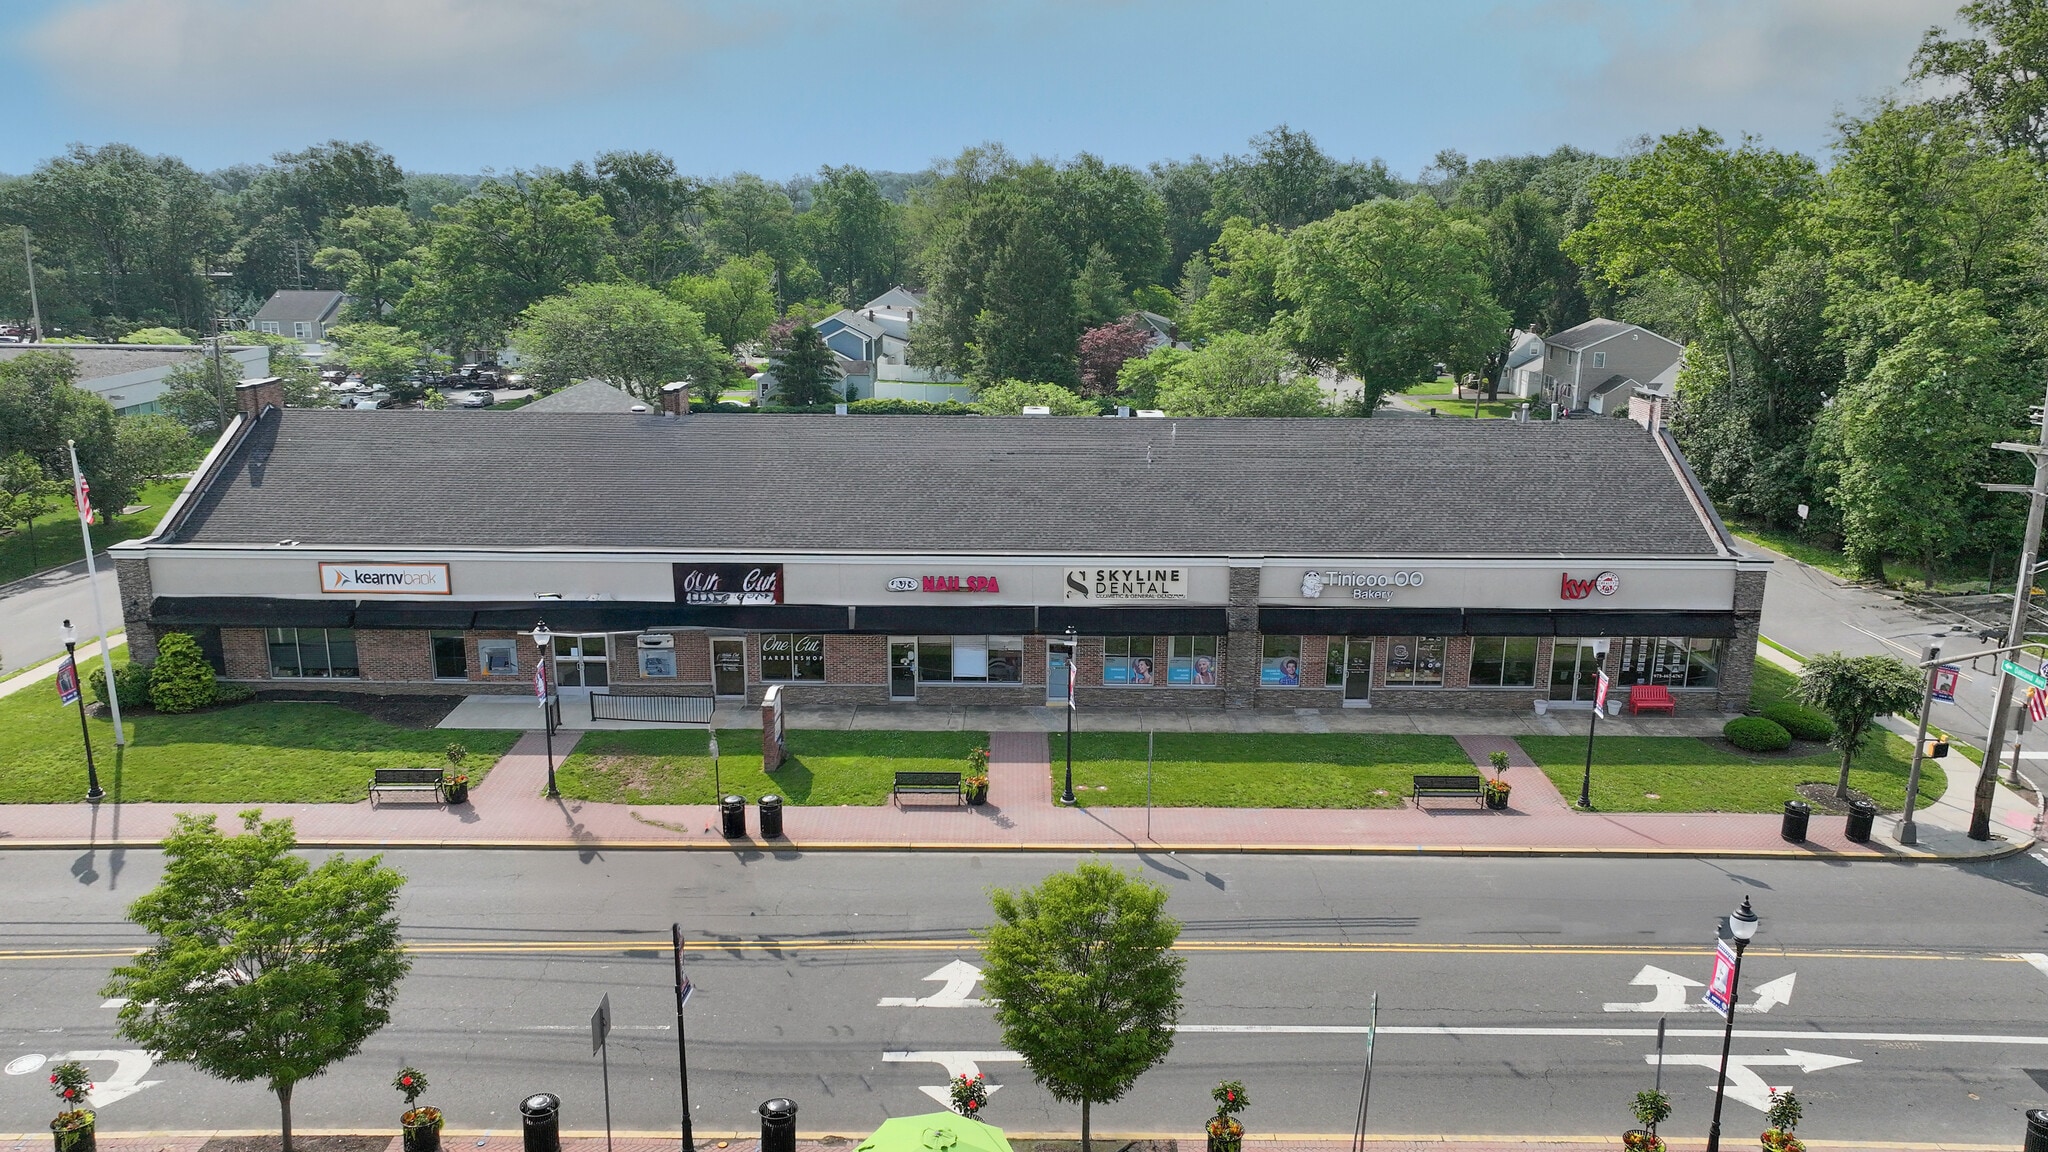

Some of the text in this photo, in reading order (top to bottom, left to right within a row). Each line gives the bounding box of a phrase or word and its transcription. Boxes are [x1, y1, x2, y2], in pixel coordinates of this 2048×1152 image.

[1096, 570, 1180, 582] SKYLINE
[1326, 571, 1424, 587] Tinicoo OO
[966, 575, 1000, 592] SPA
[1095, 582, 1169, 594] DENTAL
[1353, 589, 1394, 602] Bakery
[762, 634, 820, 652] One Cut
